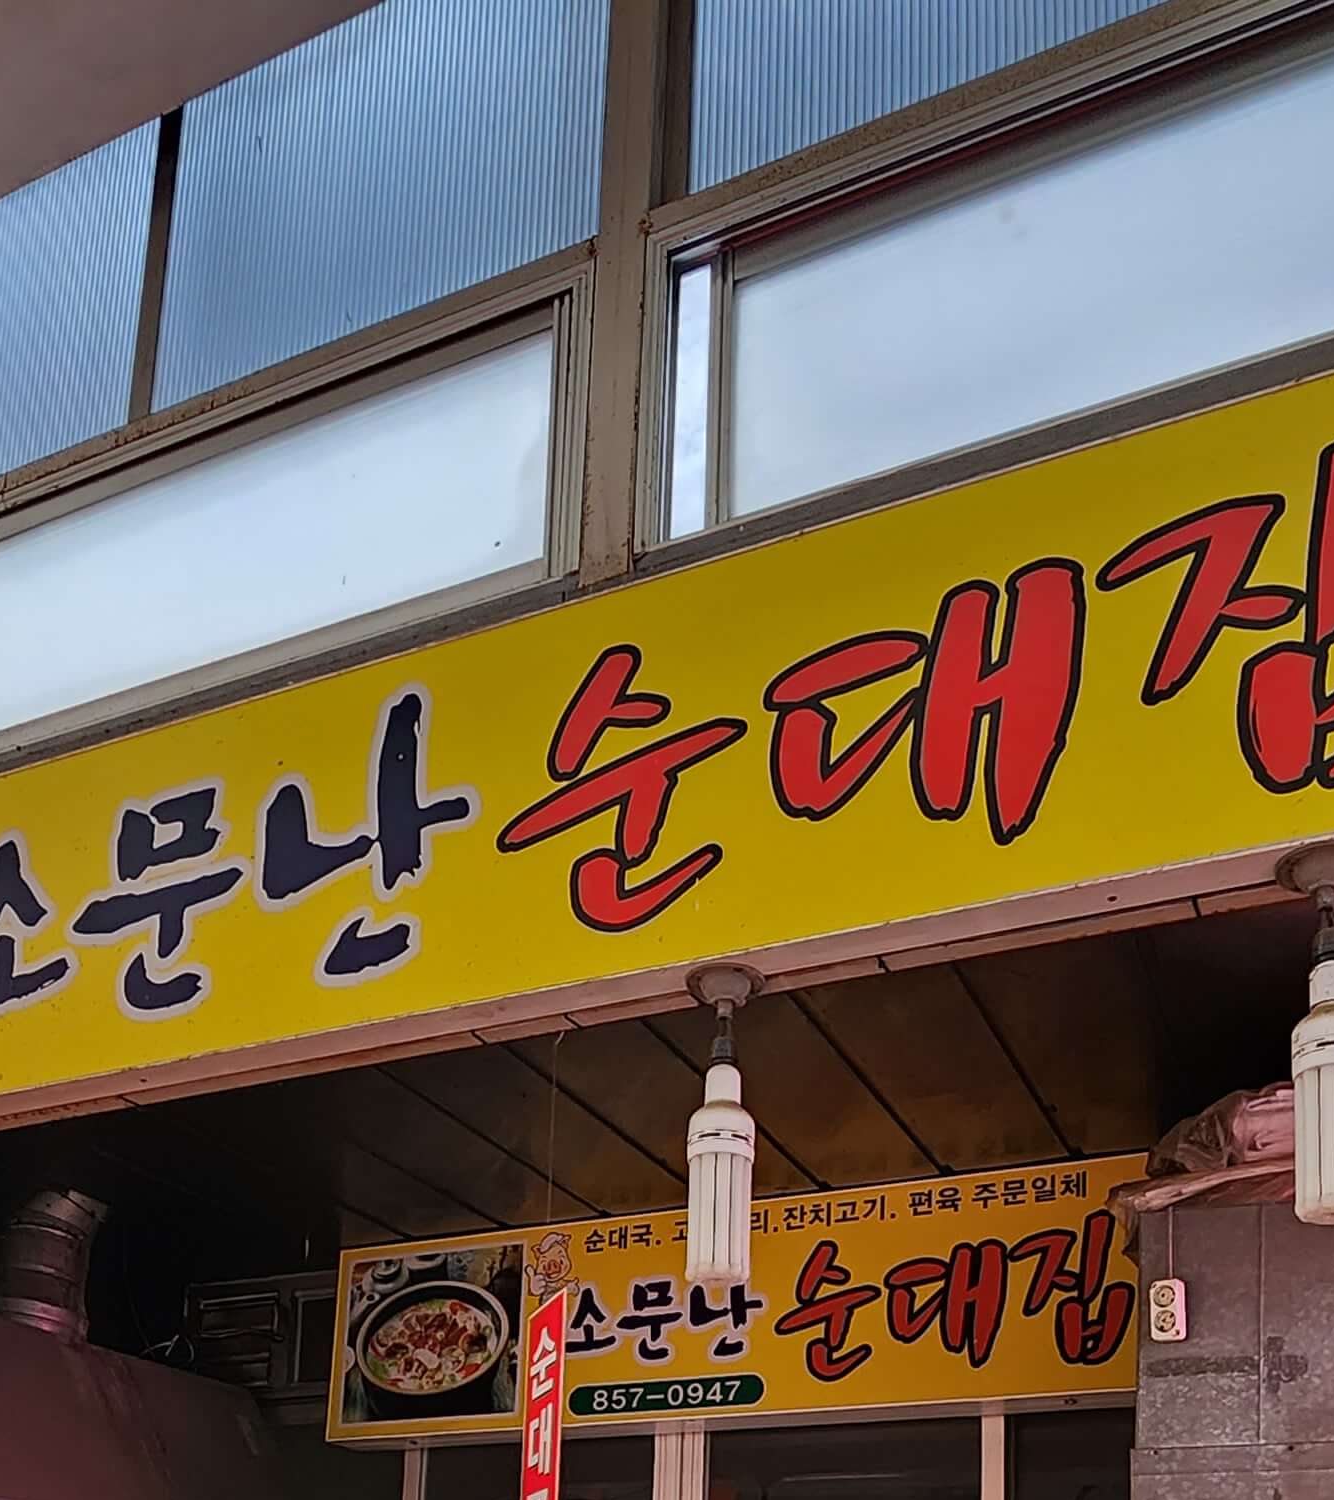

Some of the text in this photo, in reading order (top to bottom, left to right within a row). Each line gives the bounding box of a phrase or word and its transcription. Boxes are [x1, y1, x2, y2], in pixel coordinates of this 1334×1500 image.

[670, 1208, 779, 1244] 고리.
[907, 1184, 961, 1217] 편육
[970, 1171, 1089, 1209] 주문일체
[564, 1211, 1137, 1382] 소문난 순대집
[591, 1379, 743, 1411] 857-0947
